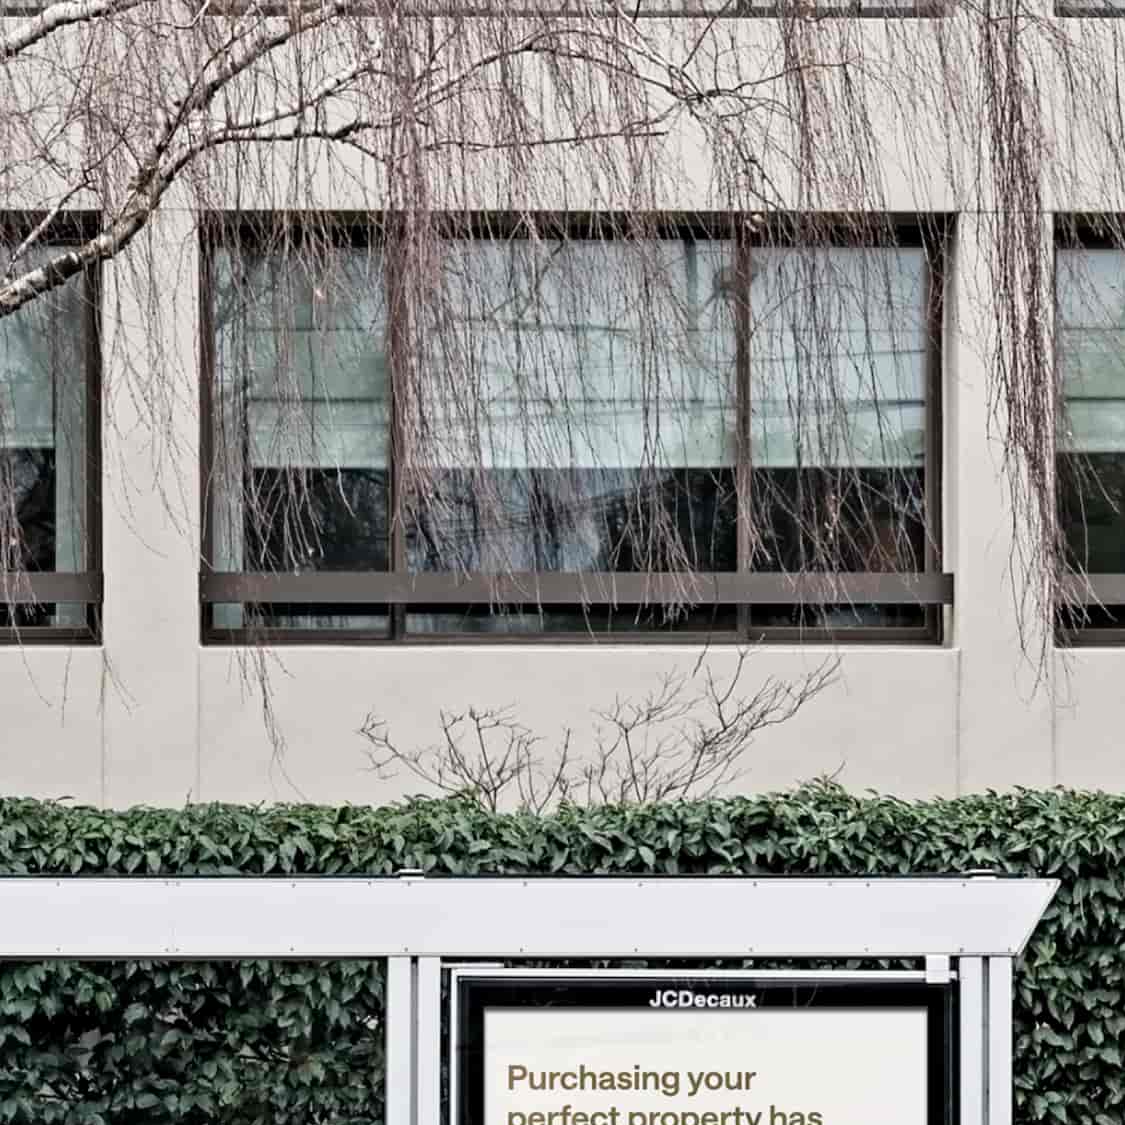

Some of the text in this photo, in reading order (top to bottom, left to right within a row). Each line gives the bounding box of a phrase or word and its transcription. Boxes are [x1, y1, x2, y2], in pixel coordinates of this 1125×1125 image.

[649, 989, 757, 1008] JCDecaux
[508, 1065, 757, 1097] Purchasing your
